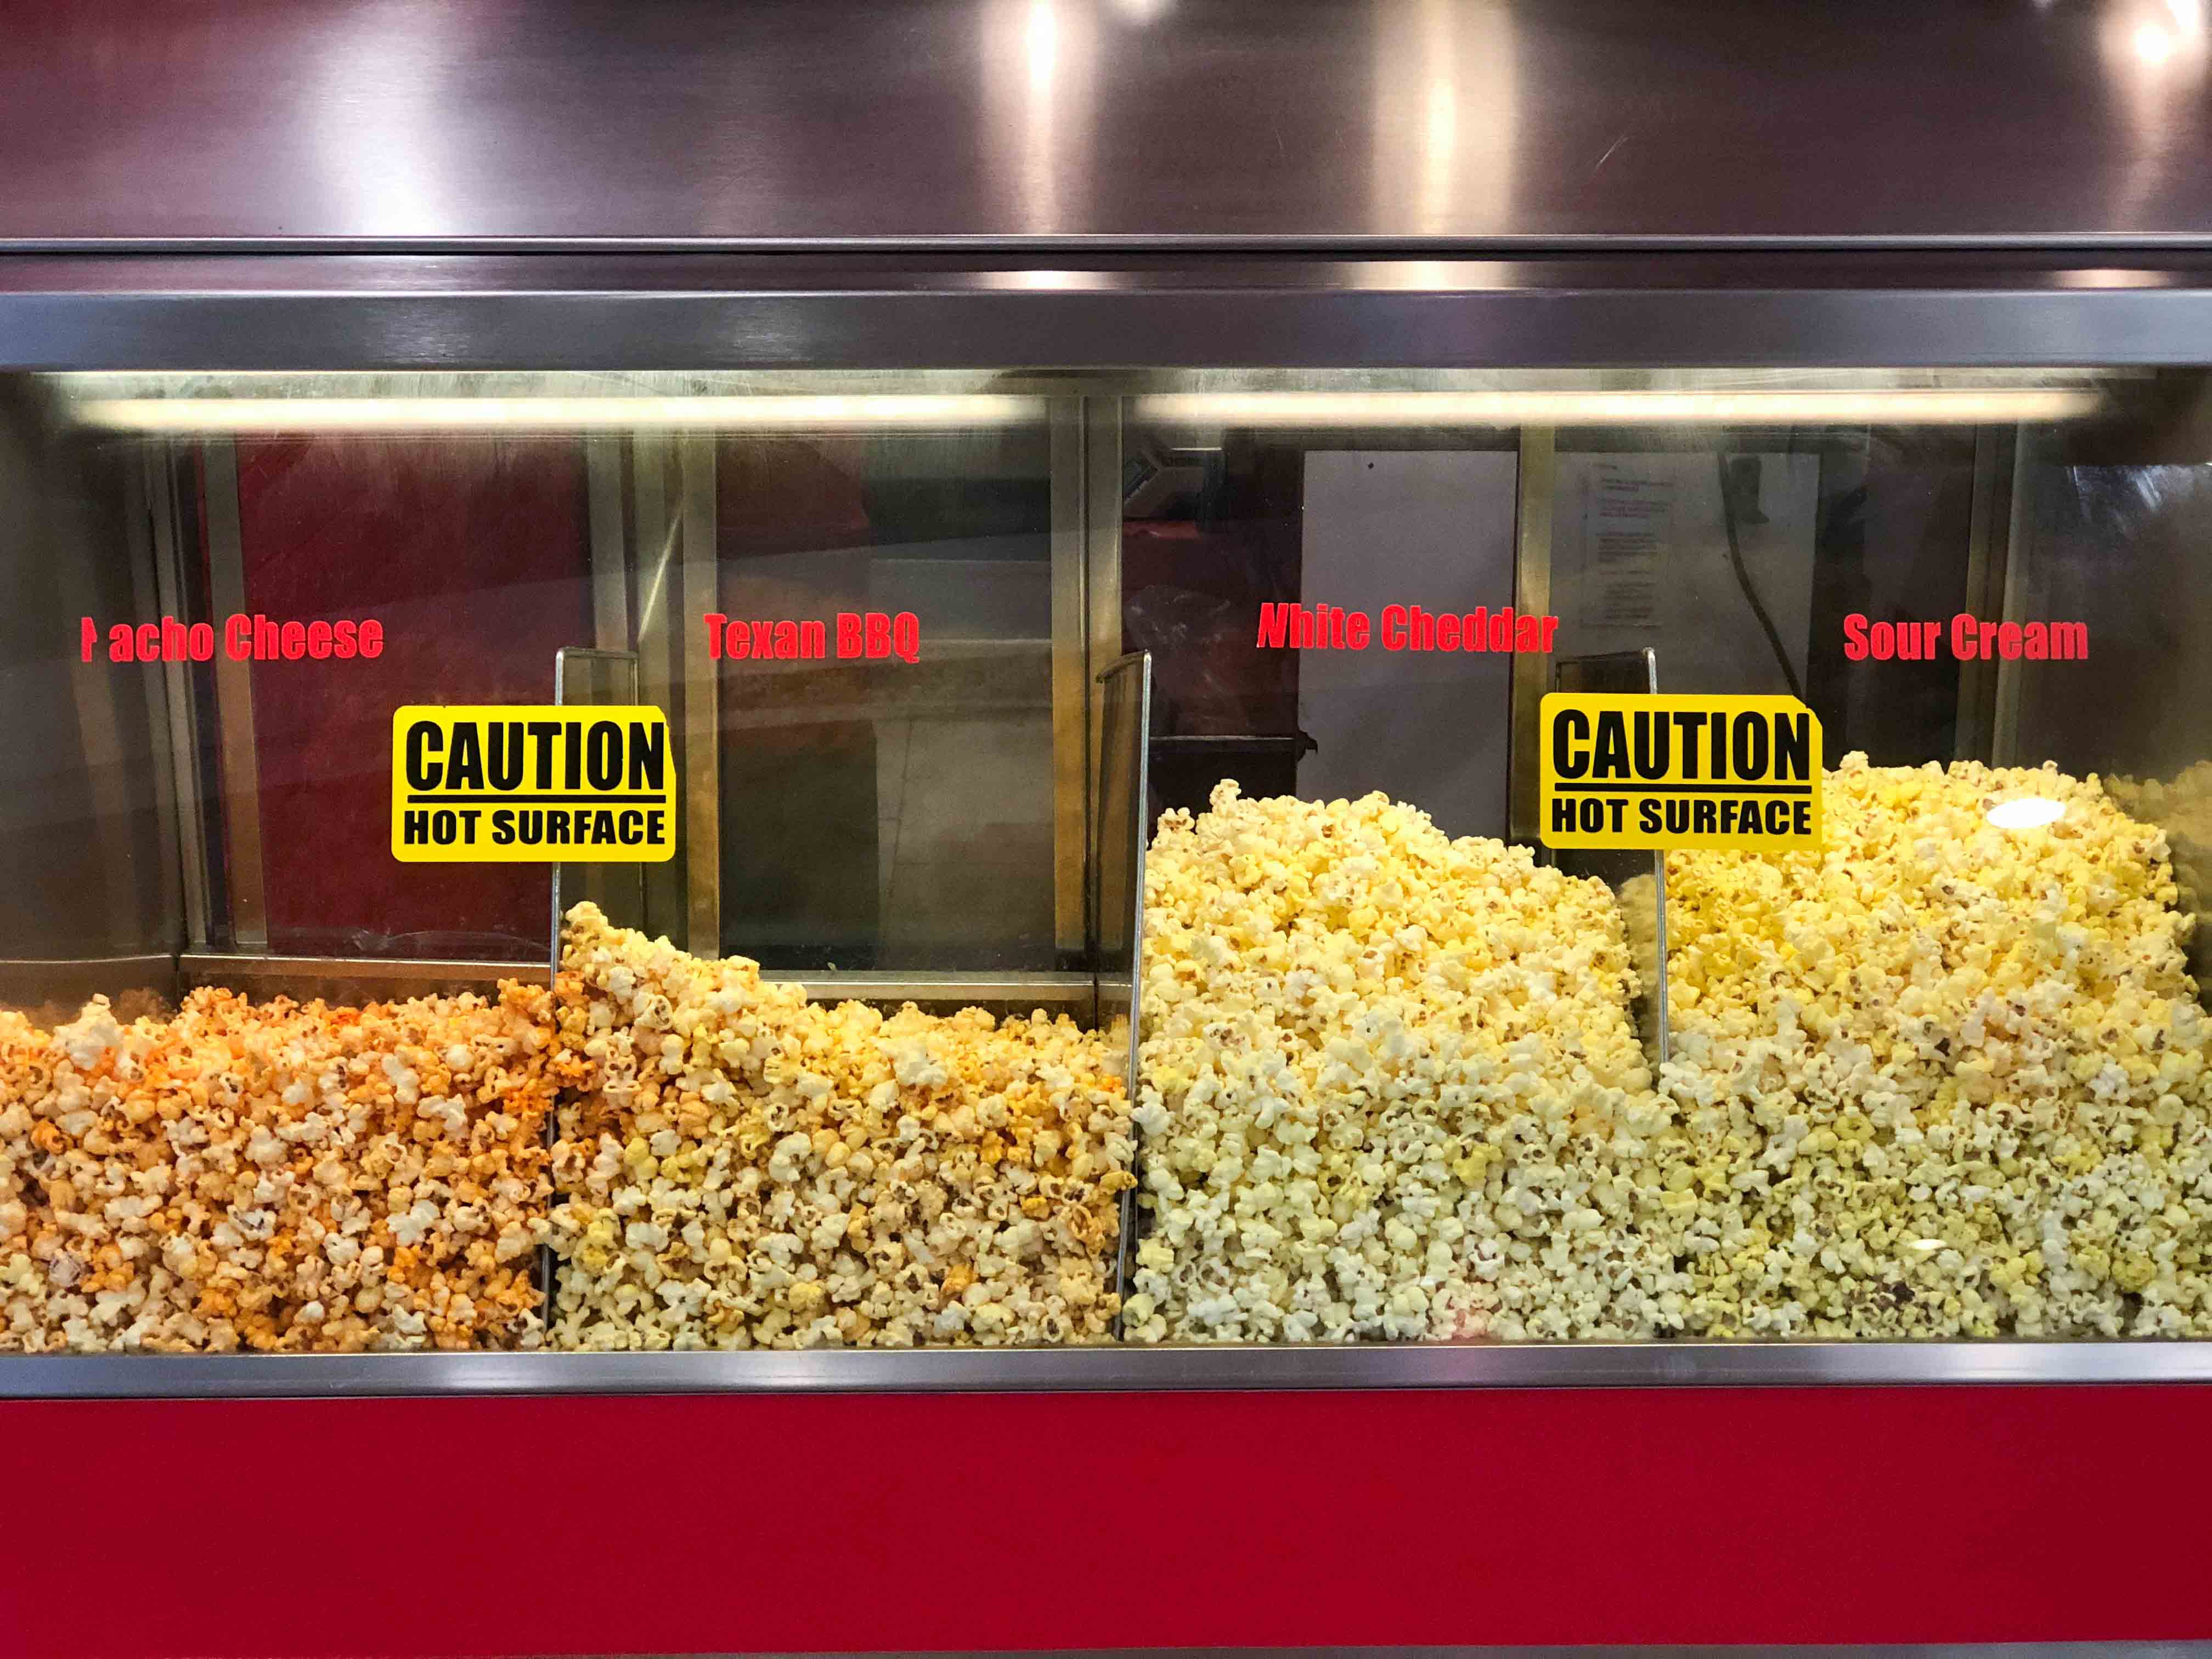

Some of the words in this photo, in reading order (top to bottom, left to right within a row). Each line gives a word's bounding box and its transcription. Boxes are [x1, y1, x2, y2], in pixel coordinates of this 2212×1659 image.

[225, 614, 383, 662] Cheese
[703, 613, 826, 659] Texan
[837, 612, 920, 663] BBQ
[1381, 605, 1559, 653] Cheddar
[1844, 613, 1941, 661] Sour
[1951, 614, 2088, 661] Cream
[406, 720, 664, 791] CAUTION
[1553, 709, 1810, 780] CAUTION
[404, 810, 481, 845] HOT
[492, 810, 665, 845] SURFACE
[1552, 798, 1629, 833] HOT
[1639, 798, 1812, 835] SURFACE
